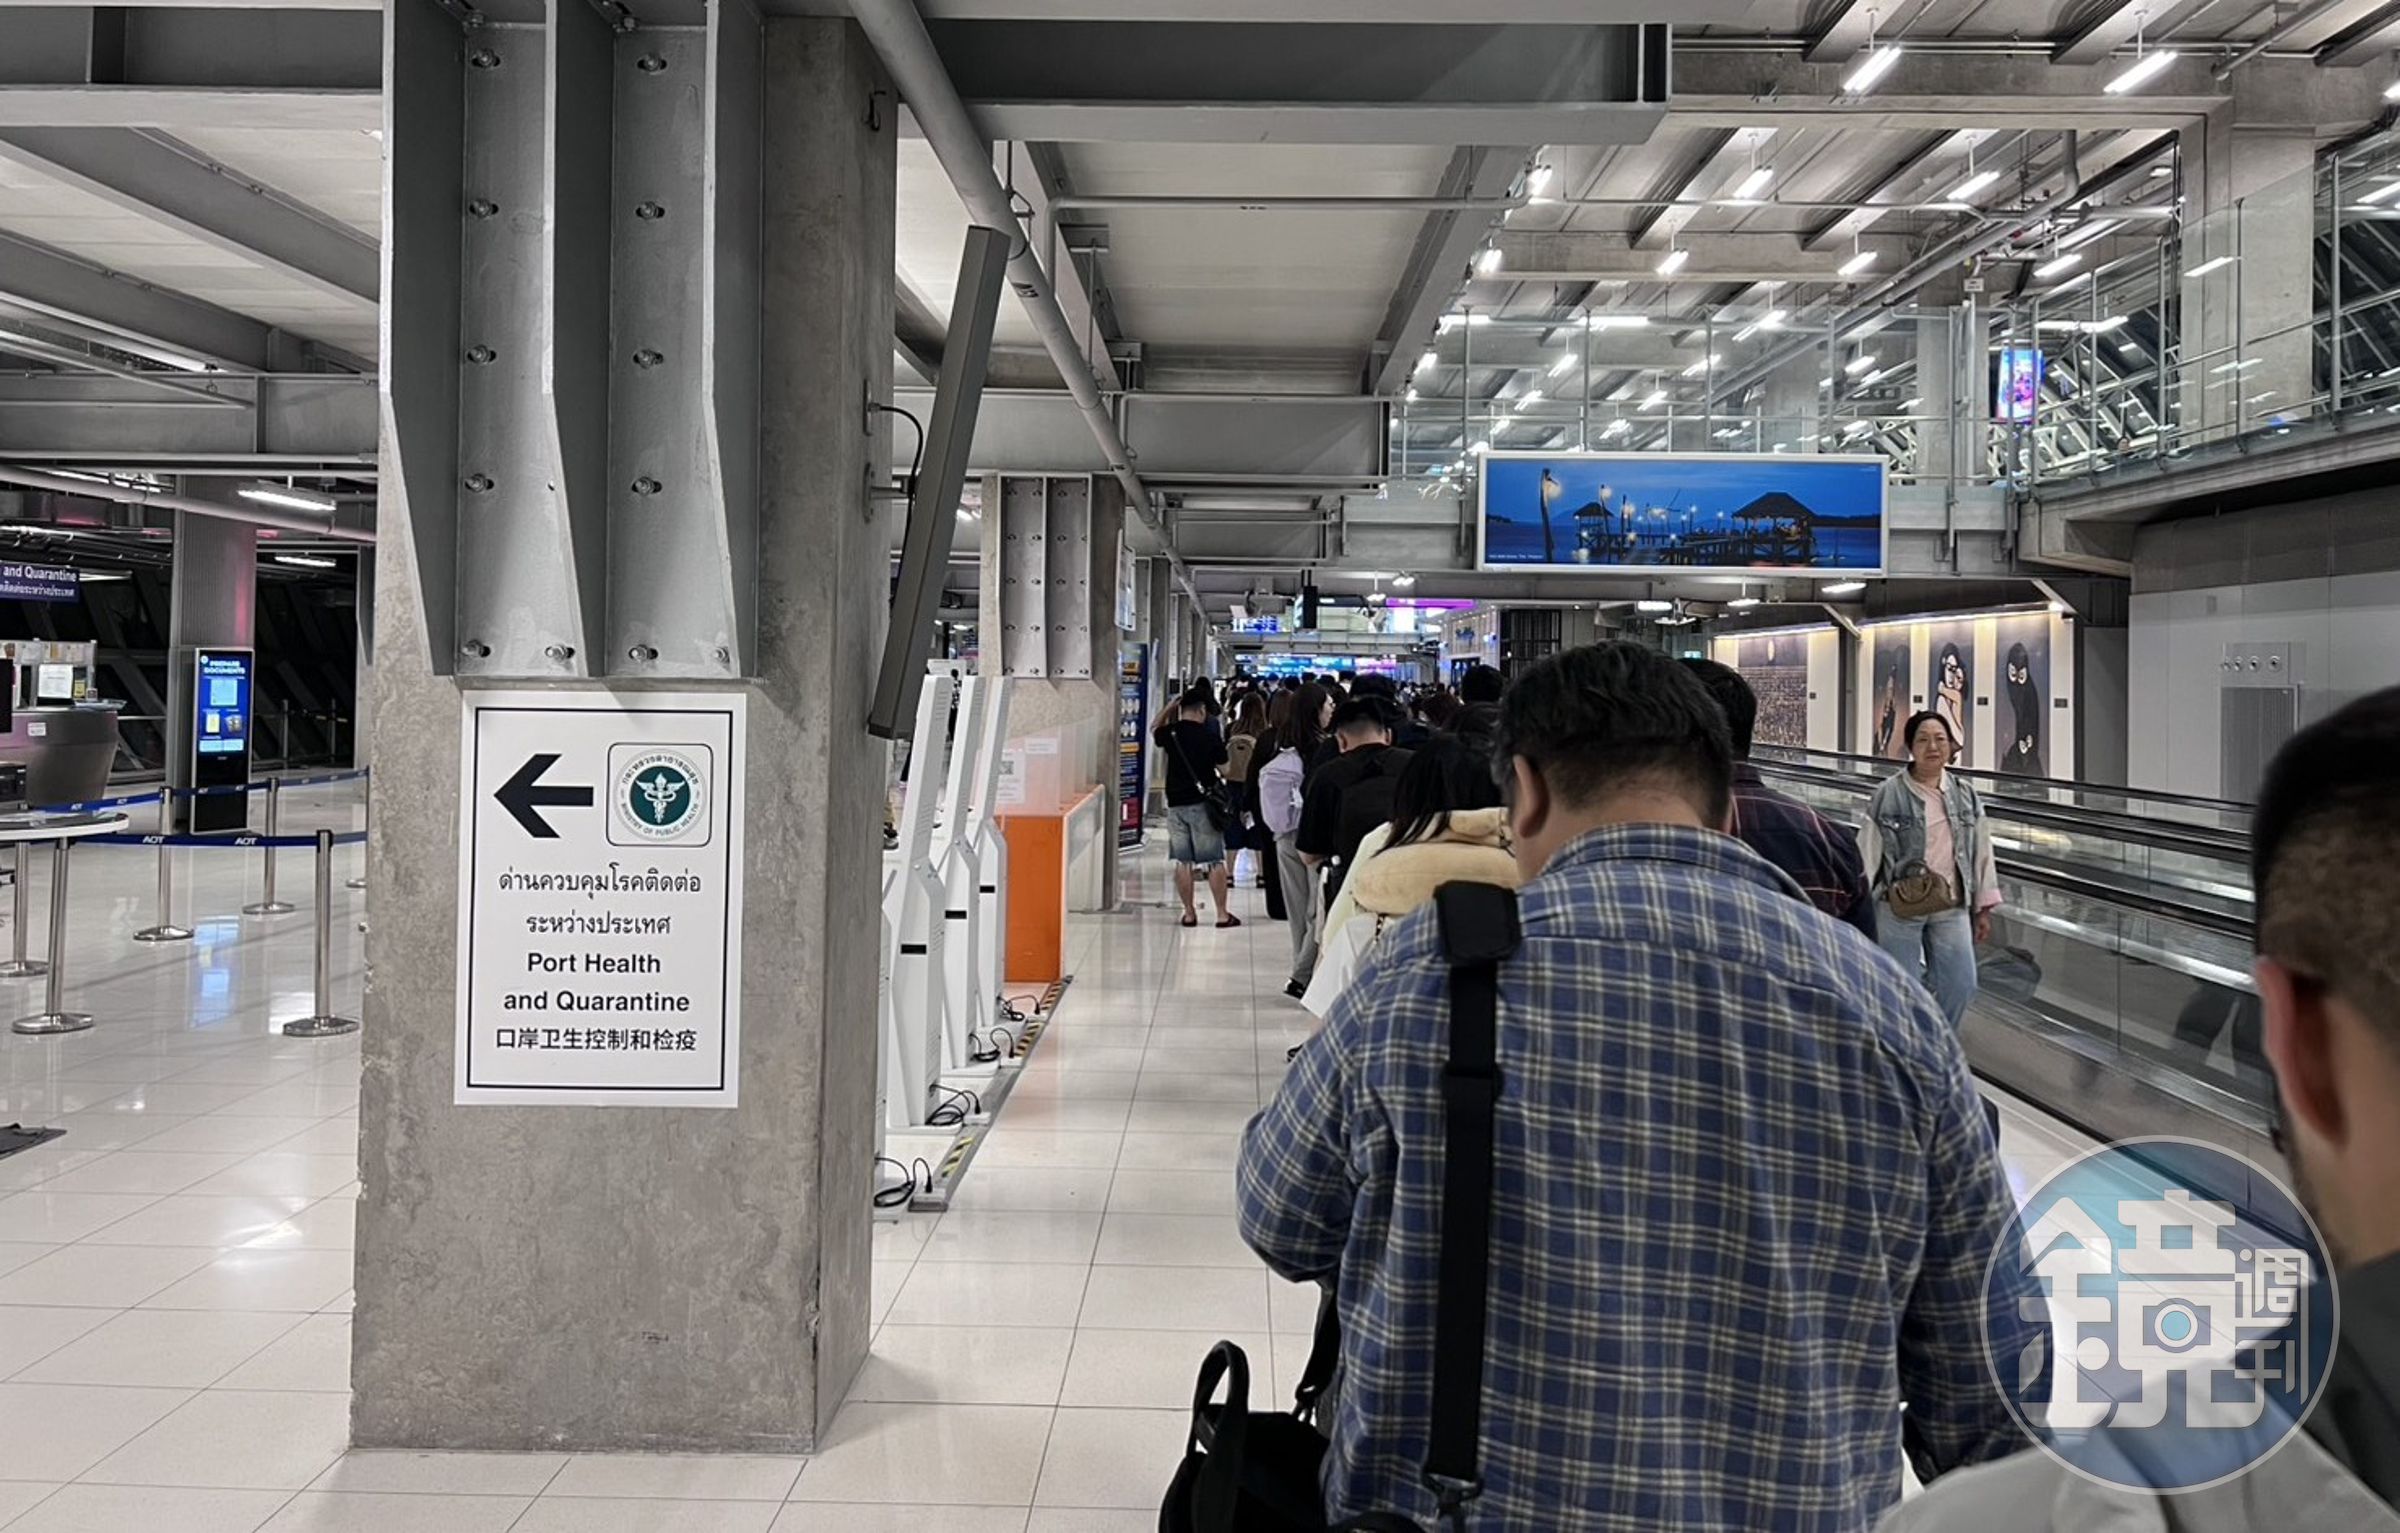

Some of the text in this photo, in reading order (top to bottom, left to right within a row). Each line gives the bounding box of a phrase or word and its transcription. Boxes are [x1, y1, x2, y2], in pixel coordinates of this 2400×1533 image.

[2, 565, 77, 582] and Quarantine
[142, 835, 165, 845] AOT
[234, 837, 258, 846] AOT
[498, 862, 702, 899] ด่านควบคุมโรคติดต่อ
[526, 909, 672, 935] ระหว่างประเทศ
[527, 952, 662, 974] Port Health
[503, 989, 691, 1012] and Quarantine
[496, 1027, 698, 1052] 口岸卫生控制和检疫
